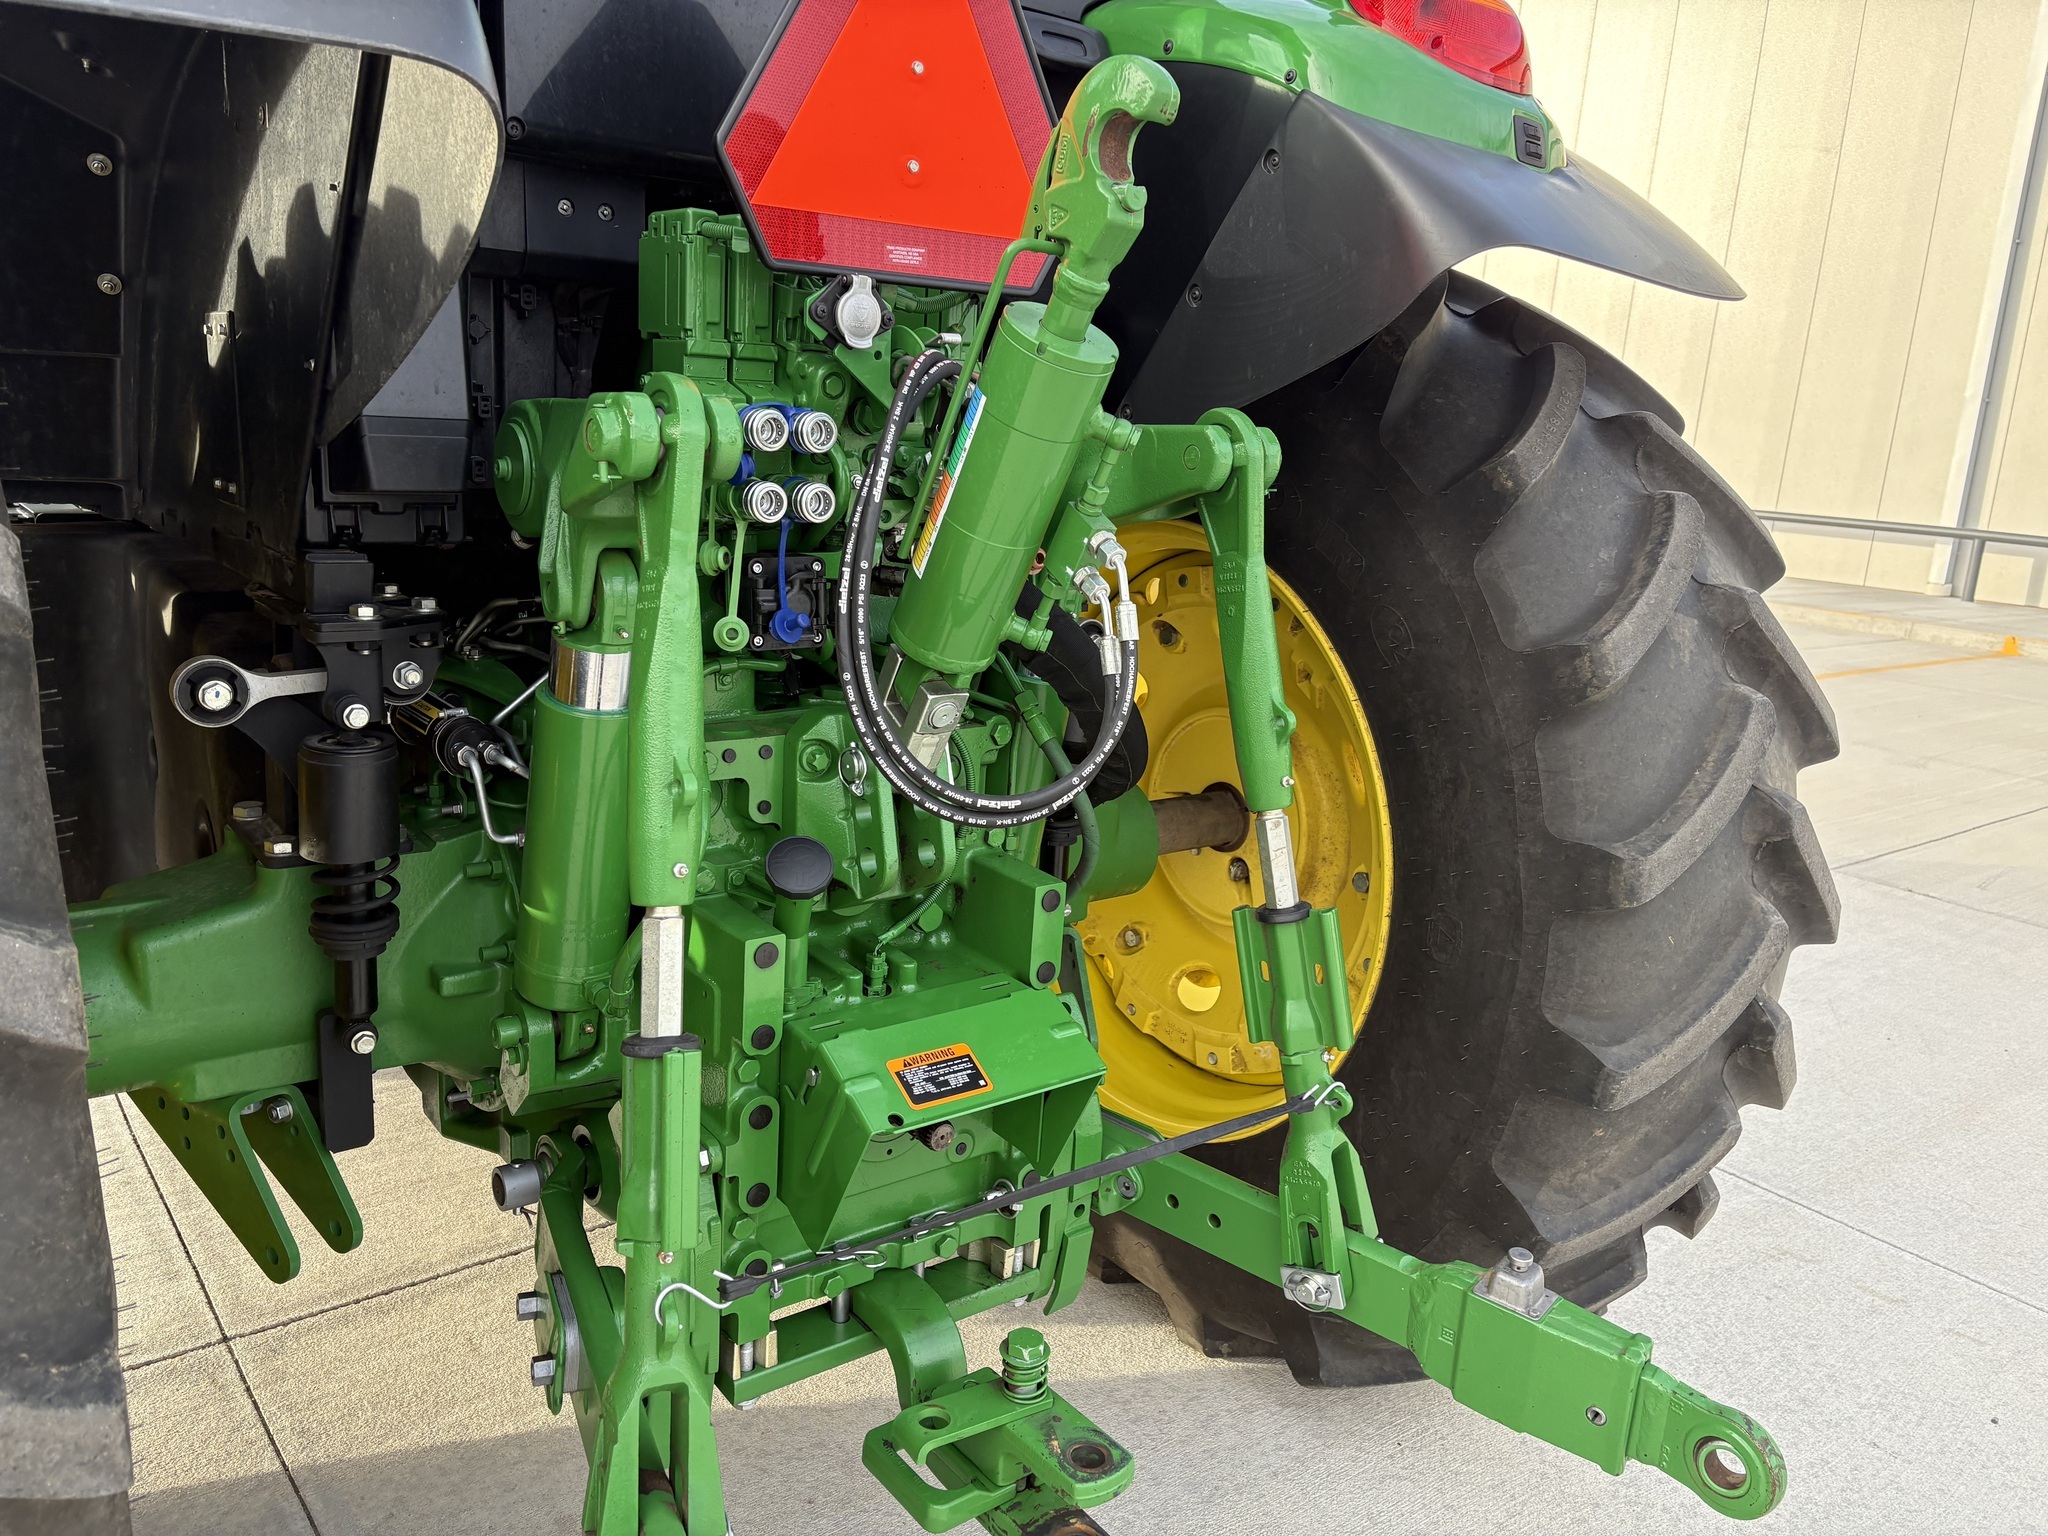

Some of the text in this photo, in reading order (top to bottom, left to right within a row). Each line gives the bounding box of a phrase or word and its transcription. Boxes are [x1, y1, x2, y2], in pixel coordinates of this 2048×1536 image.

[873, 456, 889, 502] dietzel
[839, 567, 850, 614] dietzel
[876, 716, 887, 731] BAR
[1095, 753, 1104, 763] PSI
[924, 801, 939, 812] BAR
[977, 798, 1021, 810] dietzel
[909, 1048, 956, 1065] WARNING
